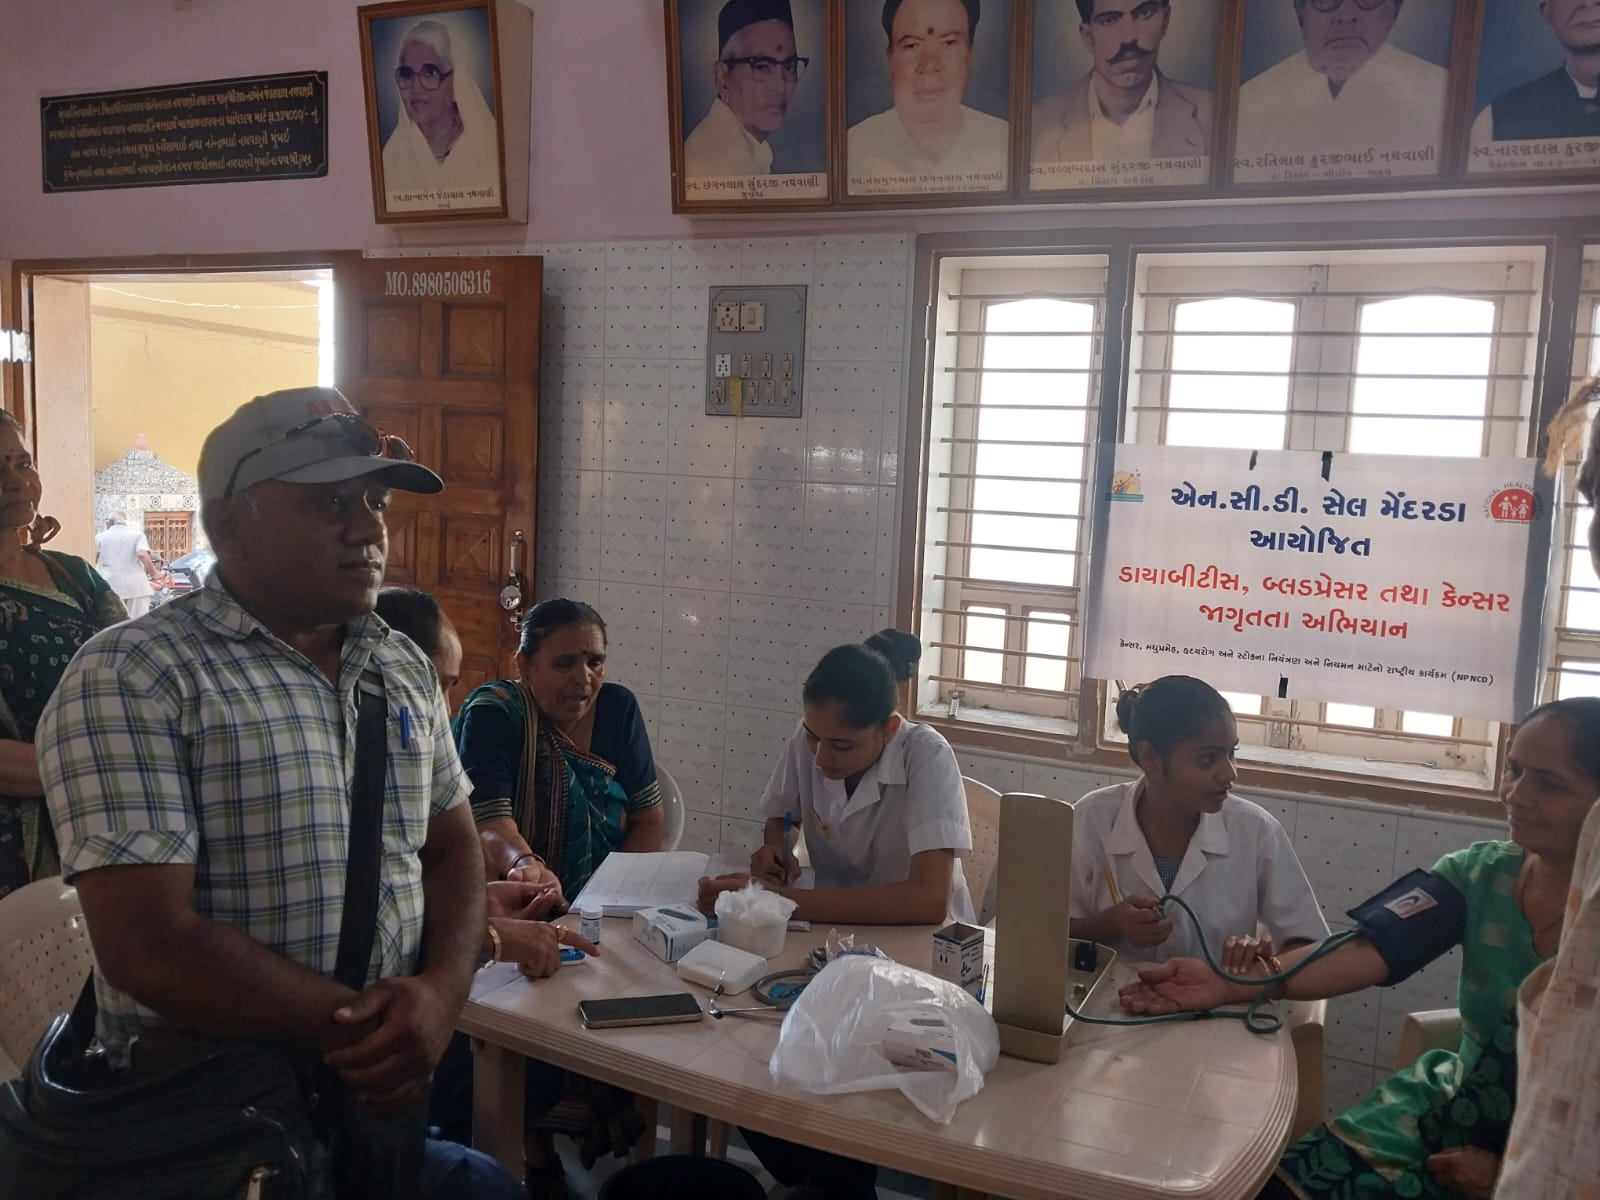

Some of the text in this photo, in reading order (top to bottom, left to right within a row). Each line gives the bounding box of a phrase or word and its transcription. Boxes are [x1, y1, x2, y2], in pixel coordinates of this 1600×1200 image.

[781, 175, 819, 188] નથવાણી
[385, 269, 492, 296] MO.8980506316
[1171, 481, 1466, 522] એન.સી.ડી. સેલ મેંદરડા
[1250, 525, 1371, 556] આયોજિત
[1119, 563, 1510, 612] ડાયાબીટીસ, બ્લડપ્રેસર તથા કેન્સર
[1199, 605, 1408, 639] જાગૃતતા અભિયાન
[1218, 649, 1234, 658] અને
[1268, 653, 1301, 664] નિયંત્રણ
[1304, 657, 1320, 666] અને
[1323, 658, 1354, 670] નિયમન
[1357, 662, 1383, 673] માટેનો
